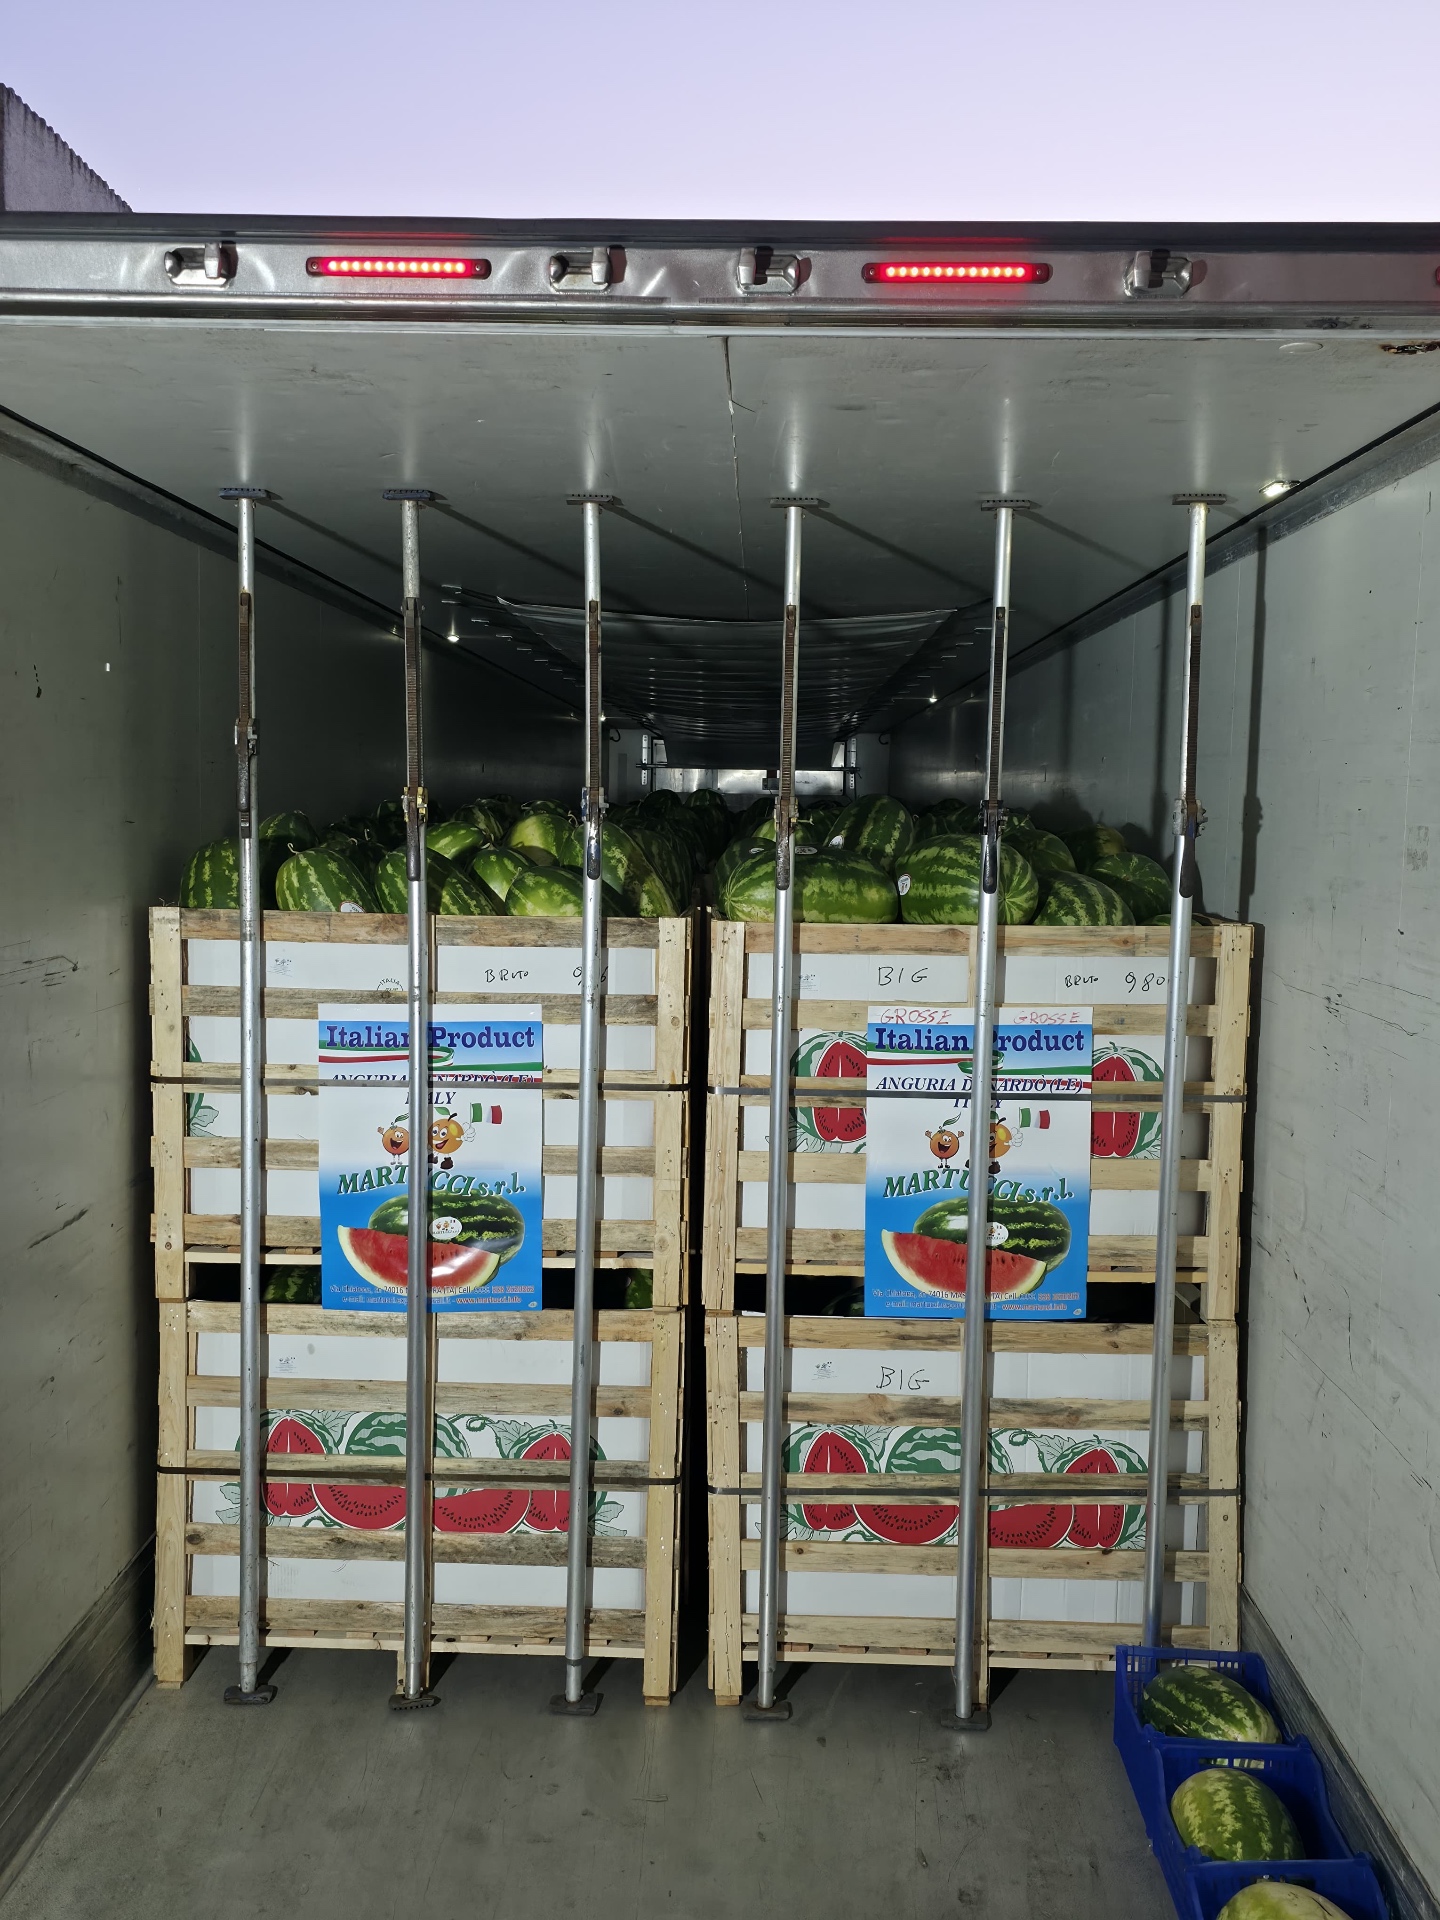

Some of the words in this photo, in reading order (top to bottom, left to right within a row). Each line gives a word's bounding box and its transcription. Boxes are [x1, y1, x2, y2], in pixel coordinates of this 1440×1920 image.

[878, 966, 928, 986] BIG
[1124, 971, 1166, 993] 980
[880, 1008, 952, 1024] GROSSE
[1013, 1011, 1082, 1025] GROSSE
[431, 1025, 535, 1049] Product
[875, 1028, 970, 1051] Italian
[876, 1076, 956, 1091] ANGURIA
[1049, 1077, 1084, 1095] (LE)
[337, 1164, 476, 1197] MARTCCI
[876, 1366, 930, 1390] BIG
